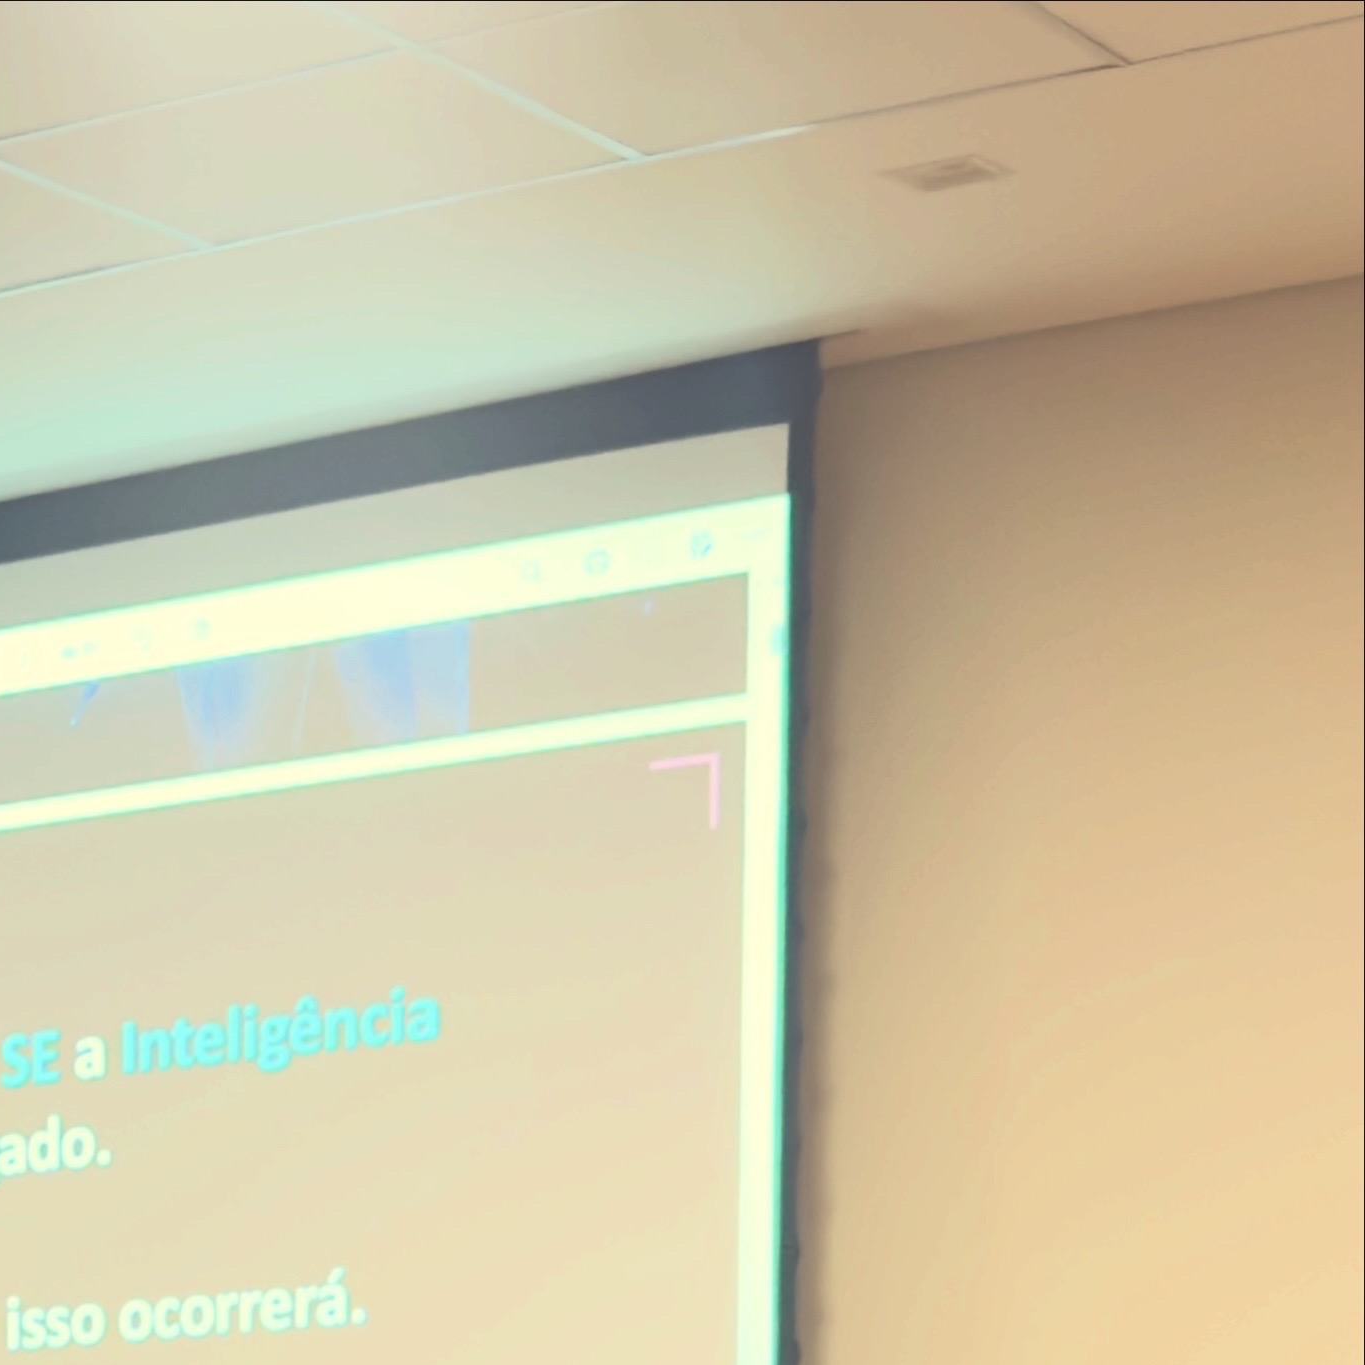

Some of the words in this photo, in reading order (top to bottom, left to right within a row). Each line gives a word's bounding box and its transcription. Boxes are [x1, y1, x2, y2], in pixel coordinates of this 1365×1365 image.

[0, 1029, 62, 1090] SE
[73, 1034, 106, 1080] a
[120, 985, 442, 1075] Inteligência
[5, 1296, 107, 1352] isso
[117, 1266, 368, 1343] ocorrerá.
